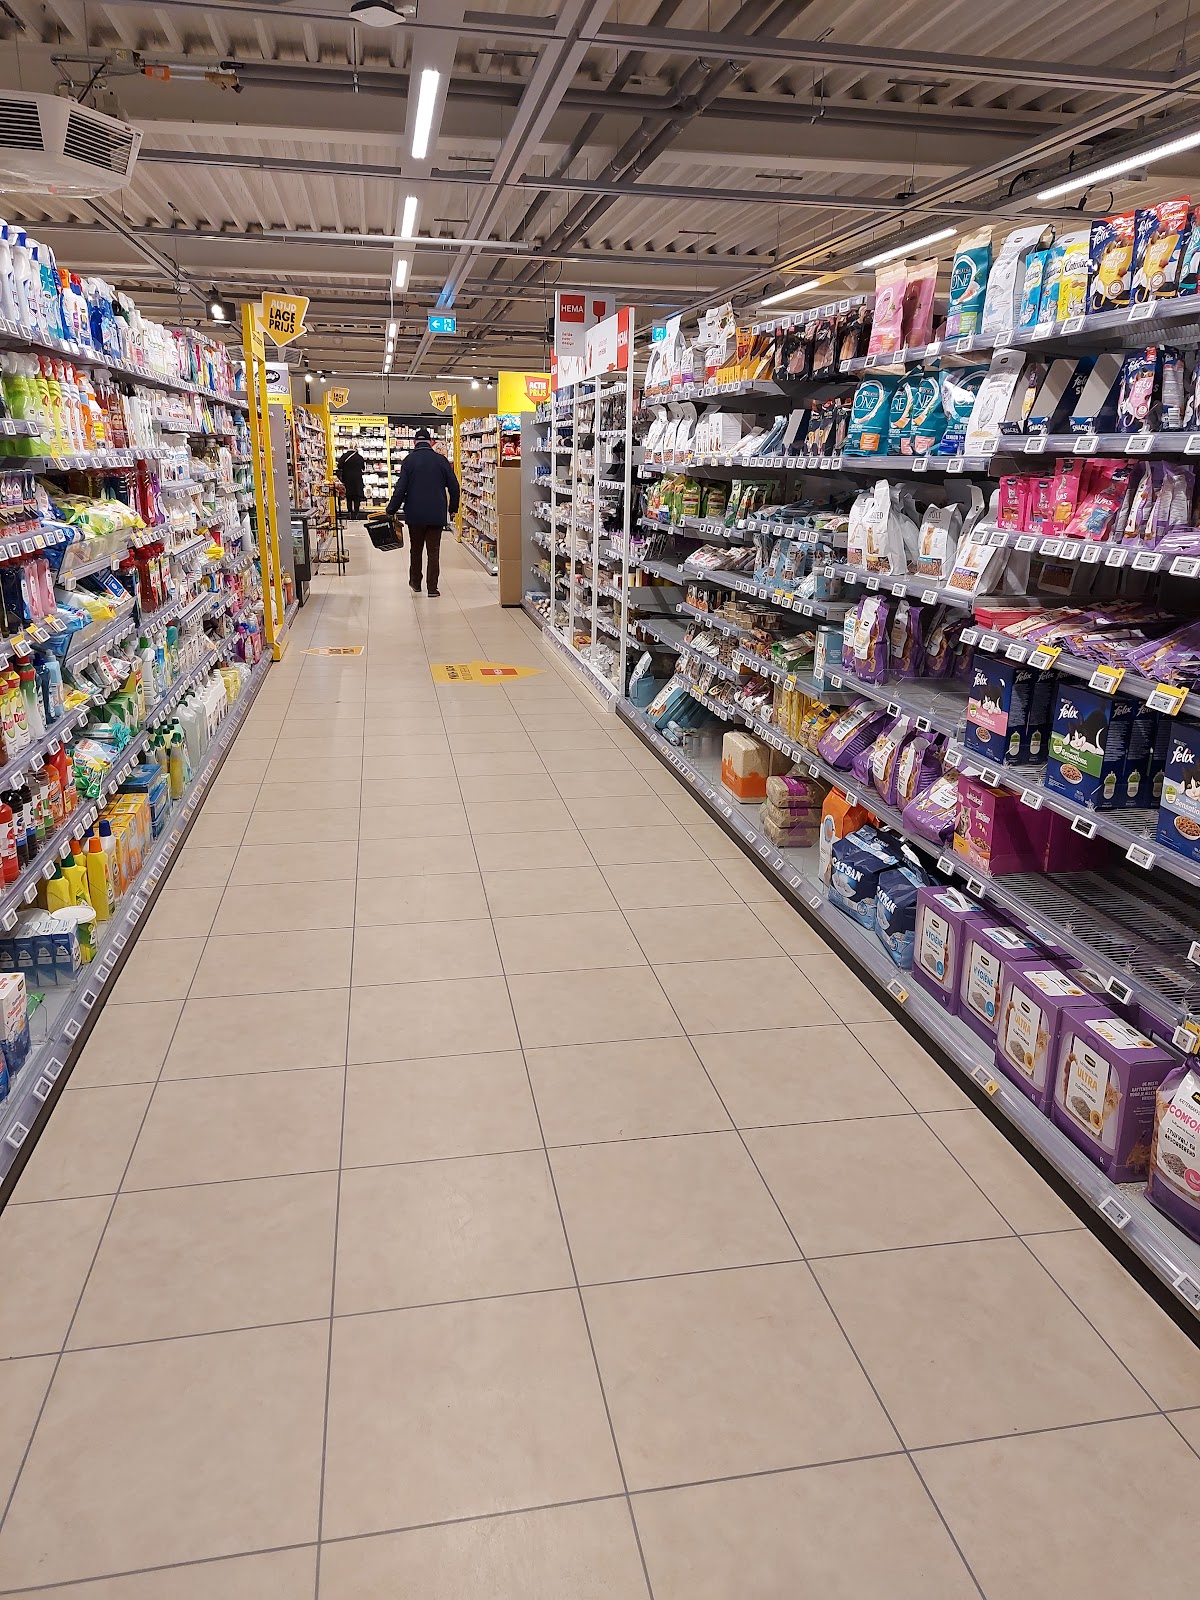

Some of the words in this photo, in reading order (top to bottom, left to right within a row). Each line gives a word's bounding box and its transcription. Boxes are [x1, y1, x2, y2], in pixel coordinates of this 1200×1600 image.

[951, 273, 971, 290] ONE
[271, 299, 297, 311] ALTIJD
[561, 304, 584, 313] HEMA
[269, 308, 296, 323] LAGE
[268, 319, 295, 334] PRIJS
[529, 381, 547, 389] ACTIE
[529, 389, 547, 397] PRIJS
[854, 394, 878, 409] ONE
[973, 672, 989, 688] felix
[1015, 671, 1033, 684] felix
[1058, 703, 1079, 721] felix
[1112, 704, 1133, 719] felix
[1170, 744, 1196, 765] felix
[832, 857, 863, 883] CATSAN
[1014, 1013, 1032, 1036] ULTRA
[1077, 1067, 1099, 1093] ULTRA
